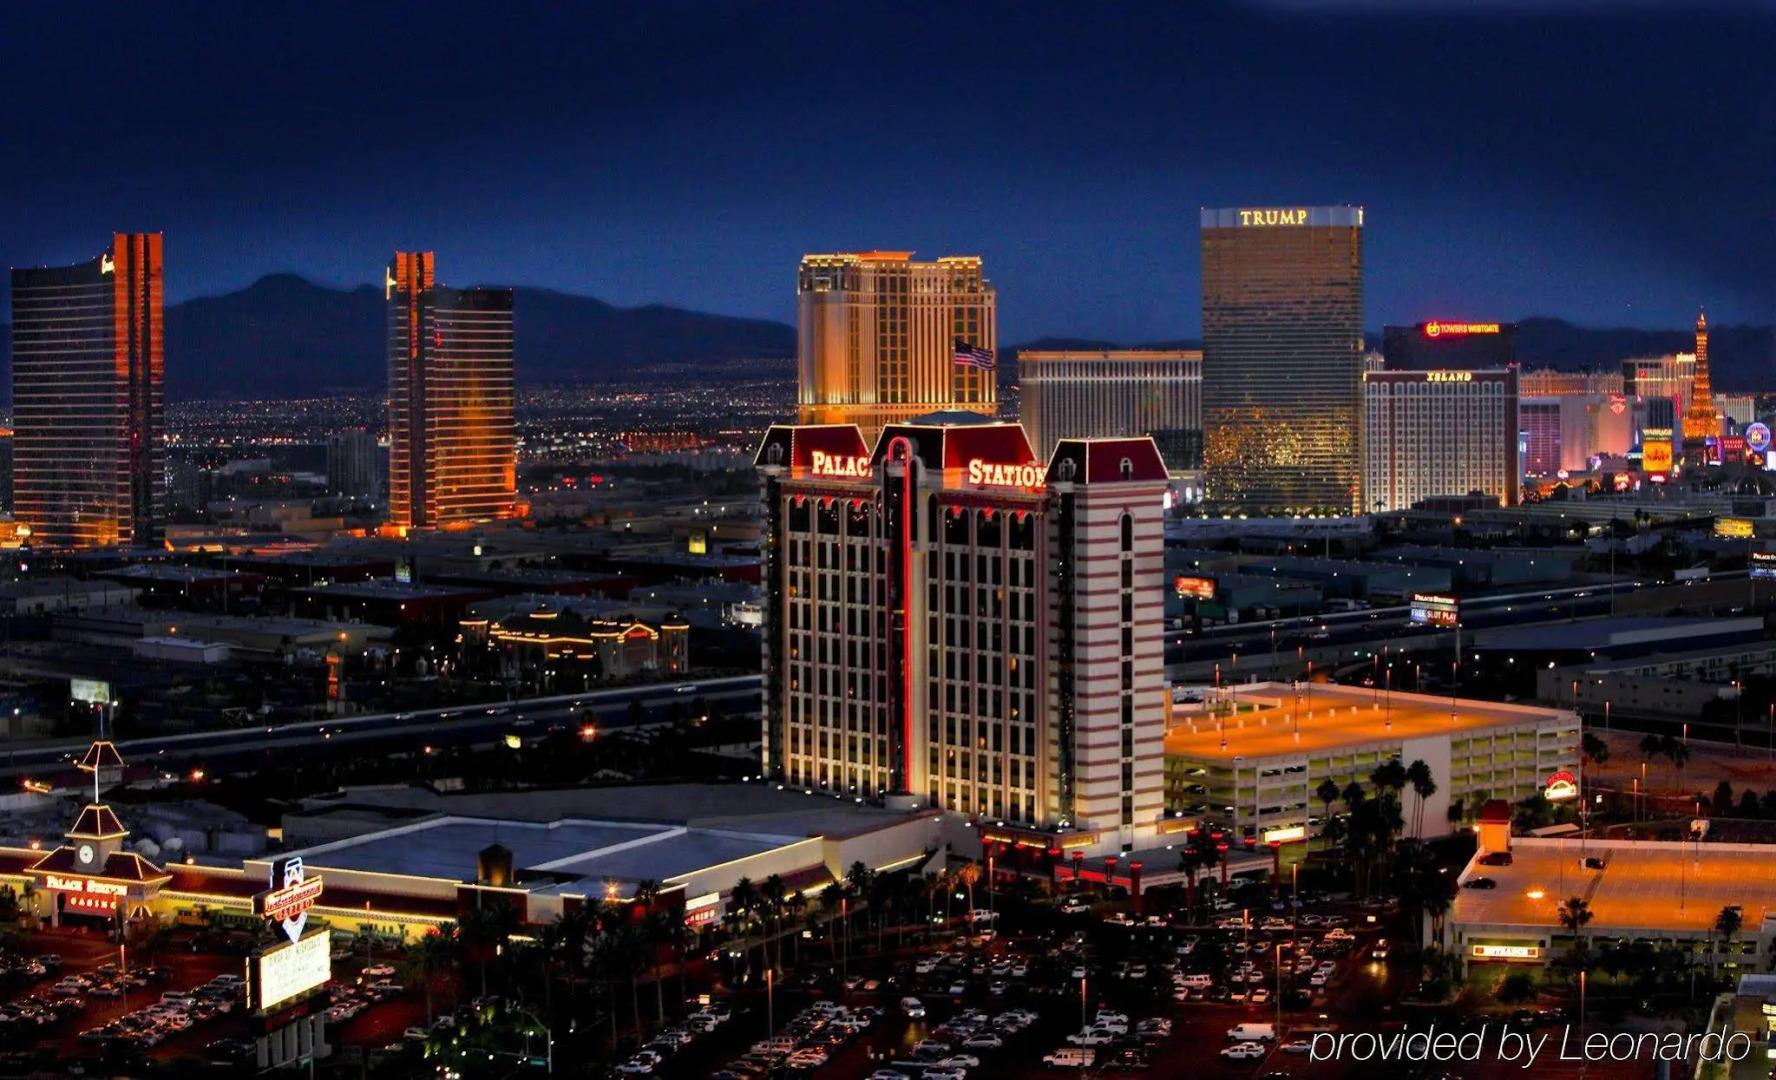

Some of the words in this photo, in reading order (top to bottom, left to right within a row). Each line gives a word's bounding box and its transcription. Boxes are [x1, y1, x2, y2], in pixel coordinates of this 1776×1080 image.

[1239, 210, 1308, 226] TRUMP
[1426, 372, 1472, 382] ISLAND
[1427, 610, 1441, 619] SLOT
[1442, 612, 1458, 620] PLAY
[70, 896, 118, 910] CASINO
